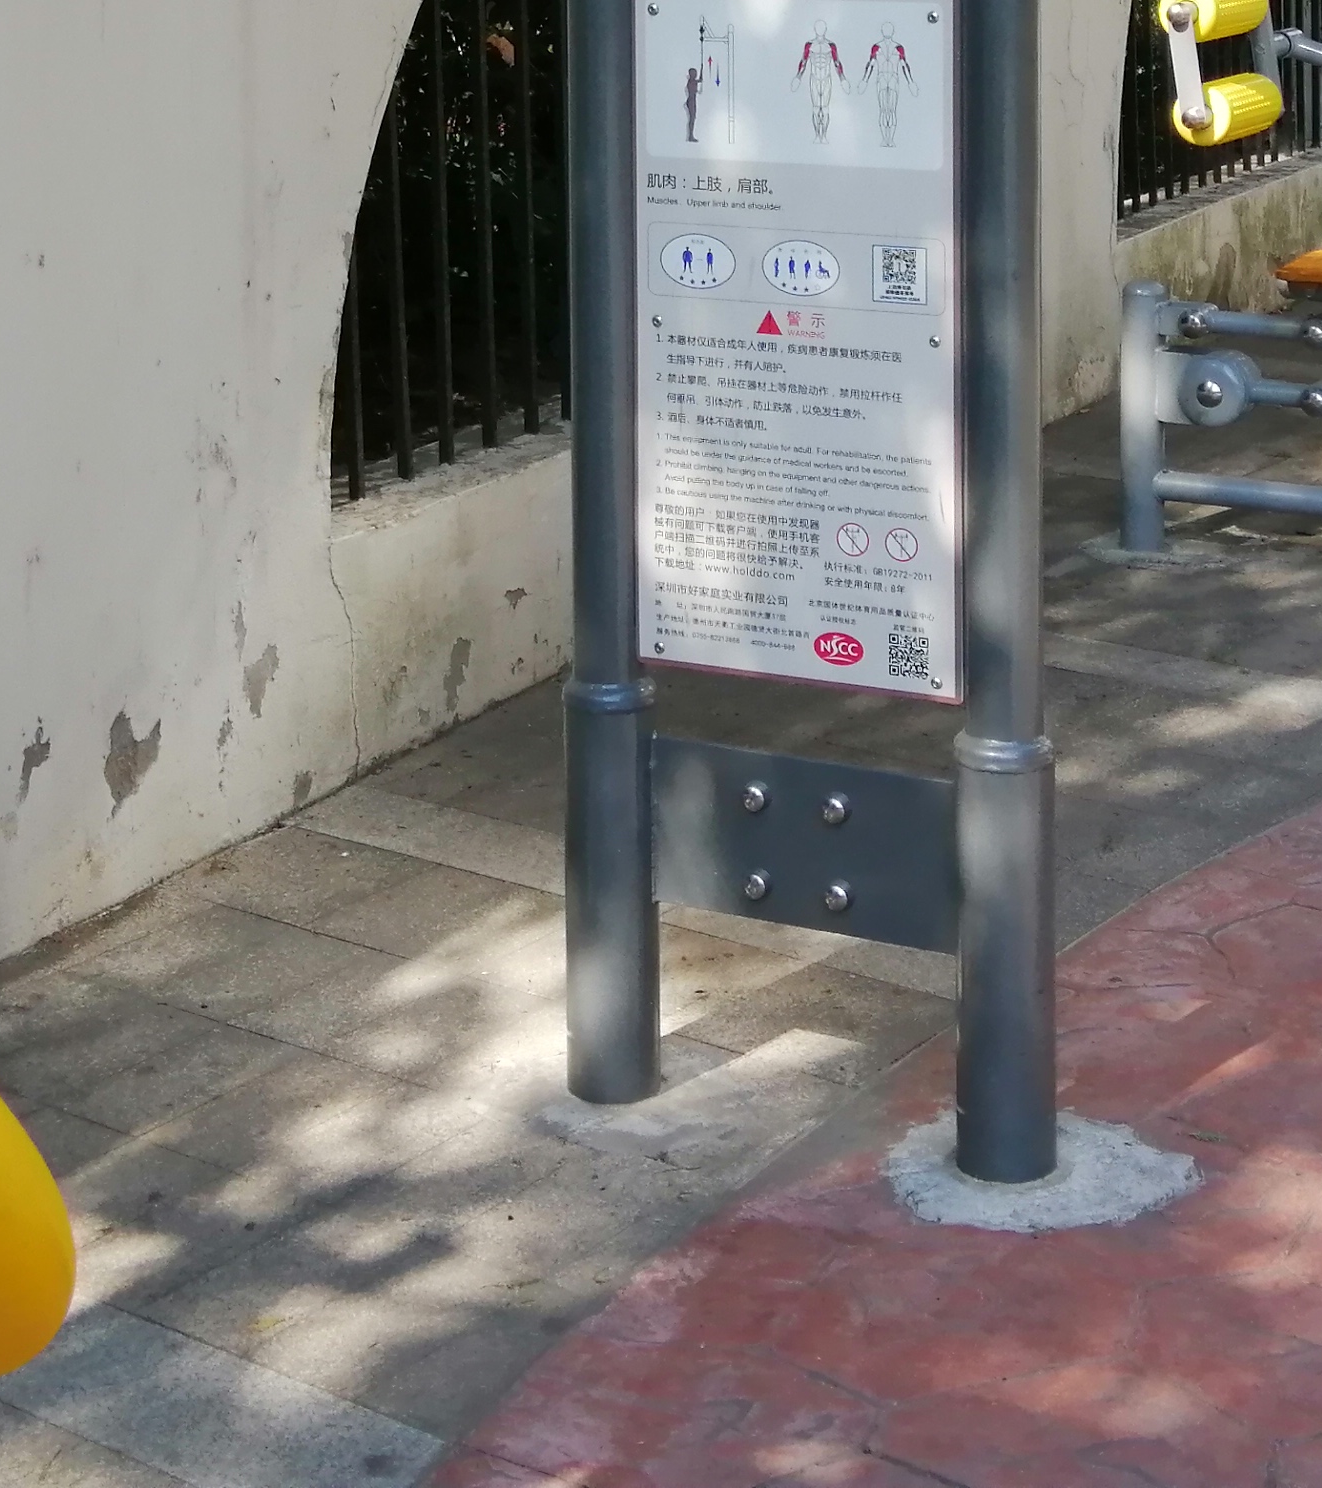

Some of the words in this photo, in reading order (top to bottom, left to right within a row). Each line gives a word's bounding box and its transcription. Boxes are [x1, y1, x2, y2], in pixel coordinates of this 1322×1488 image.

[647, 173, 773, 195] 肌肉：上肢，肩部。
[686, 198, 710, 208] Upper
[712, 200, 728, 208] limb
[731, 201, 745, 209] and
[787, 330, 825, 339] WARNING
[664, 447, 688, 456] should
[690, 449, 700, 457] be
[724, 452, 736, 460] the
[773, 456, 780, 464] of
[782, 458, 811, 468] medical
[813, 462, 843, 471] workers
[845, 465, 859, 473] and
[861, 465, 871, 474] be
[731, 440, 747, 449] only
[749, 442, 779, 451] suitable
[780, 444, 791, 452] for
[817, 447, 829, 455] For
[886, 454, 898, 462] the
[726, 466, 756, 478] hanging
[769, 470, 780, 479] the
[782, 473, 821, 484] equipment
[822, 476, 837, 484] and
[838, 477, 857, 486] other
[859, 479, 900, 491] dangerous
[726, 480, 743, 490] body
[745, 483, 755, 491] up
[785, 486, 793, 494] of
[794, 487, 817, 497] falling
[665, 487, 675, 495] Be
[730, 494, 742, 502] the
[743, 496, 775, 505] machine
[777, 498, 794, 507] after
[795, 501, 825, 512] drinking
[837, 505, 853, 514] with
[854, 506, 885, 518] physical
[655, 581, 788, 607] 深圳市好家庭实业有限公司
[820, 635, 858, 657] NSCC
